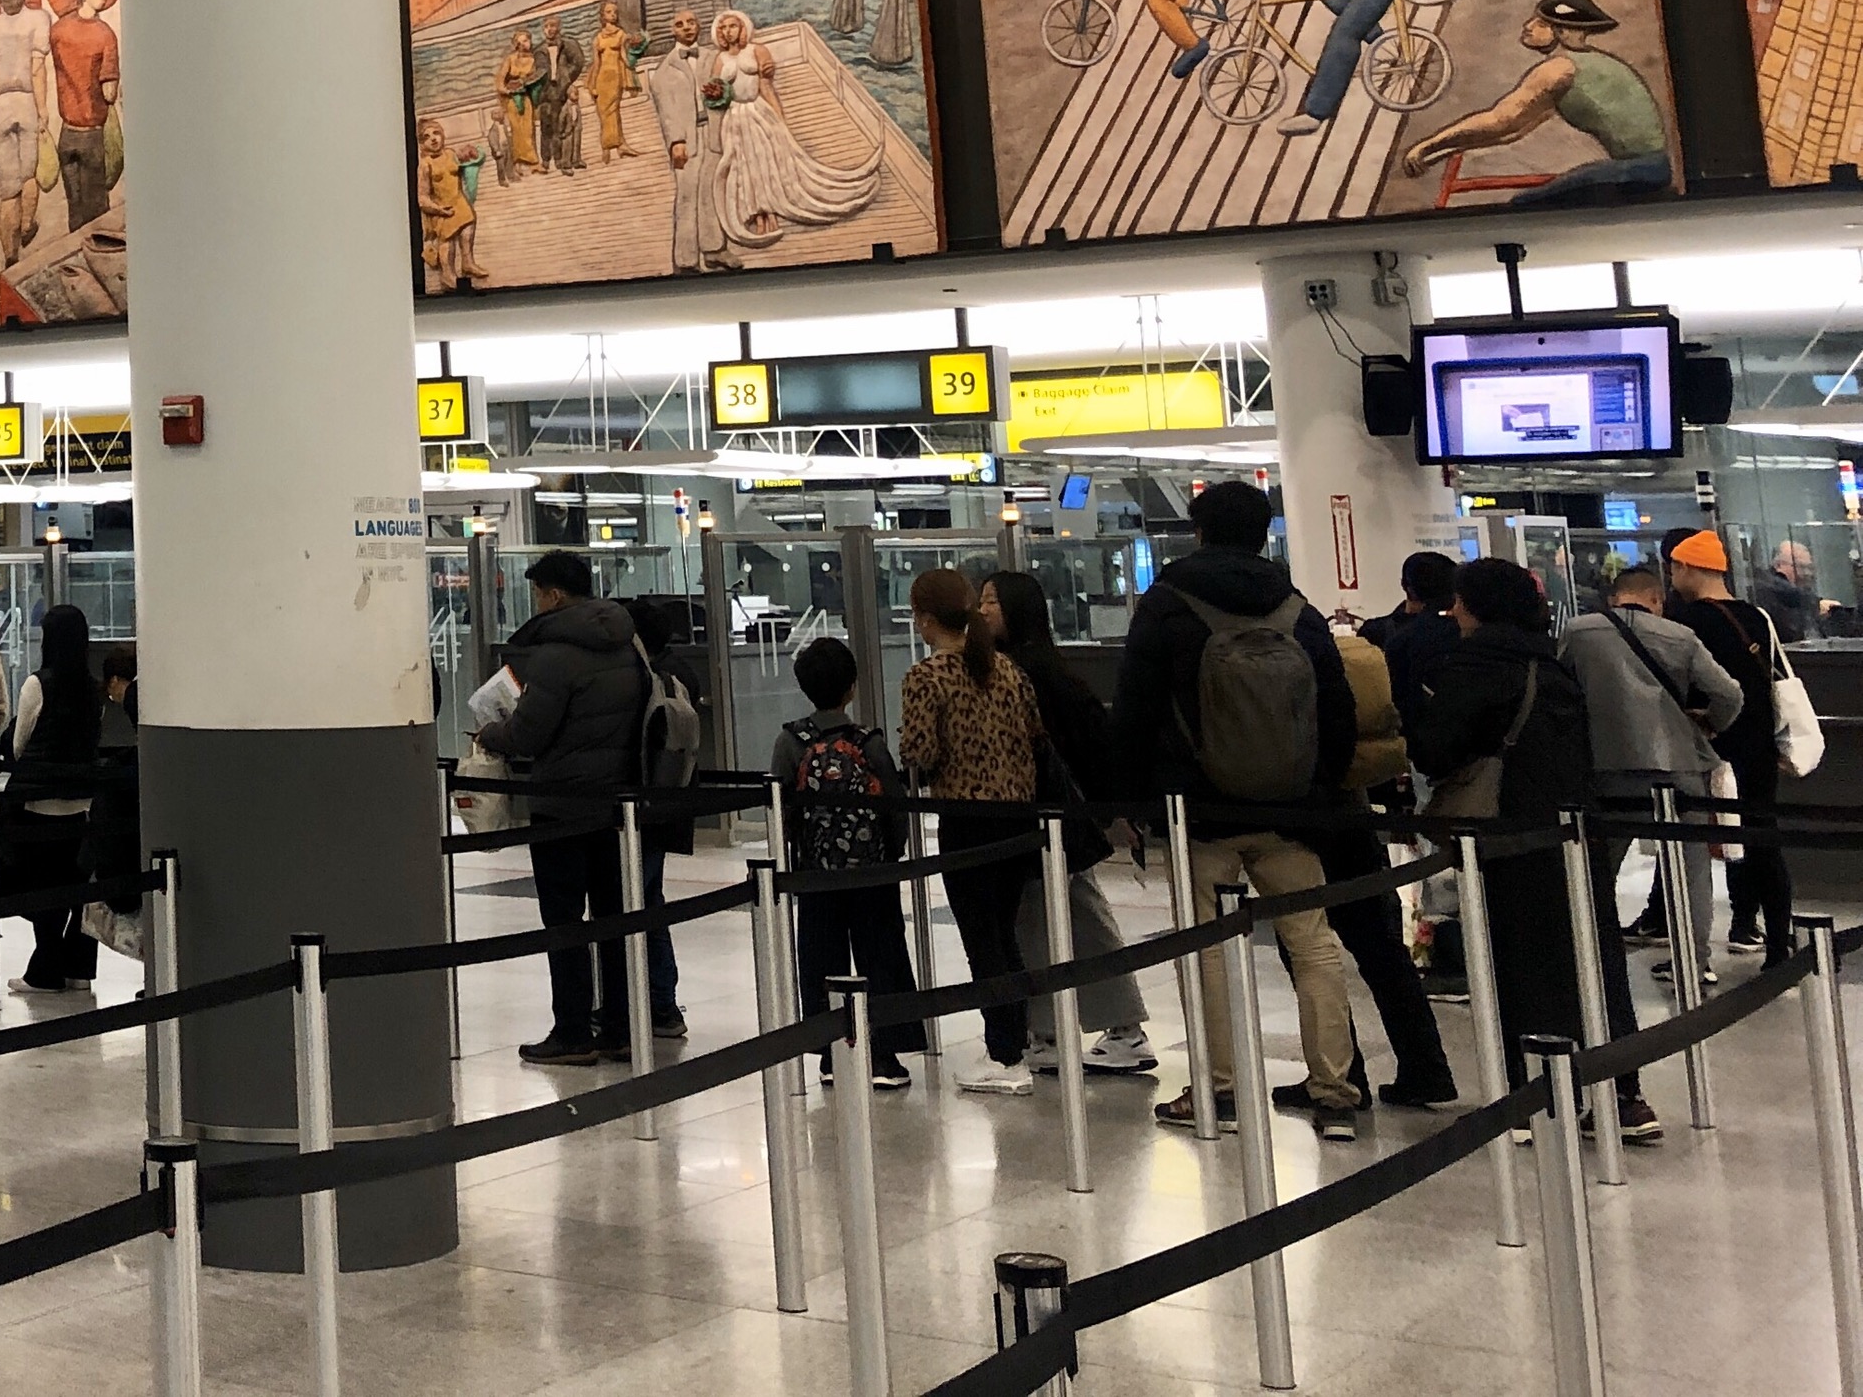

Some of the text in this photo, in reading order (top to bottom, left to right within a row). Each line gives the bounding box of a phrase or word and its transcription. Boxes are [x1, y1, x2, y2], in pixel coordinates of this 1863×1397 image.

[727, 383, 757, 406] 38
[943, 371, 976, 396] 39
[1033, 387, 1089, 400] Baggage
[428, 398, 454, 420] 37
